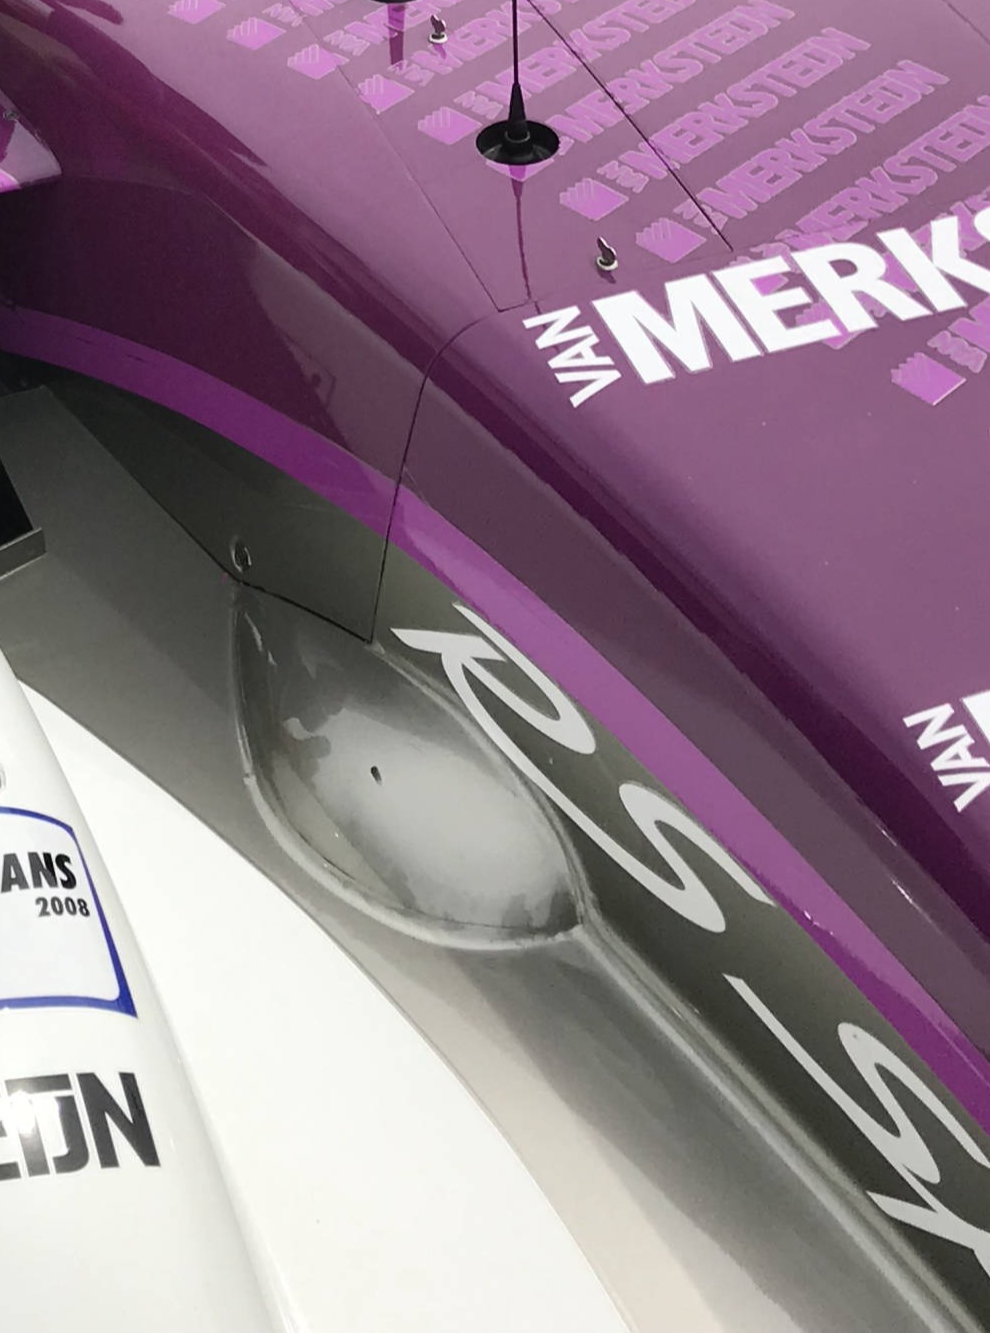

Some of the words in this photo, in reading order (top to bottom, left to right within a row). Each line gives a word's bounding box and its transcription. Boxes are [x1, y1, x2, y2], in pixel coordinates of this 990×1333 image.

[618, 26, 872, 180] MERKSTEIJN
[694, 59, 950, 220] MERKSTEIJN
[522, 306, 622, 408] VAN
[902, 702, 990, 813] VAN
[34, 896, 91, 918] 2008
